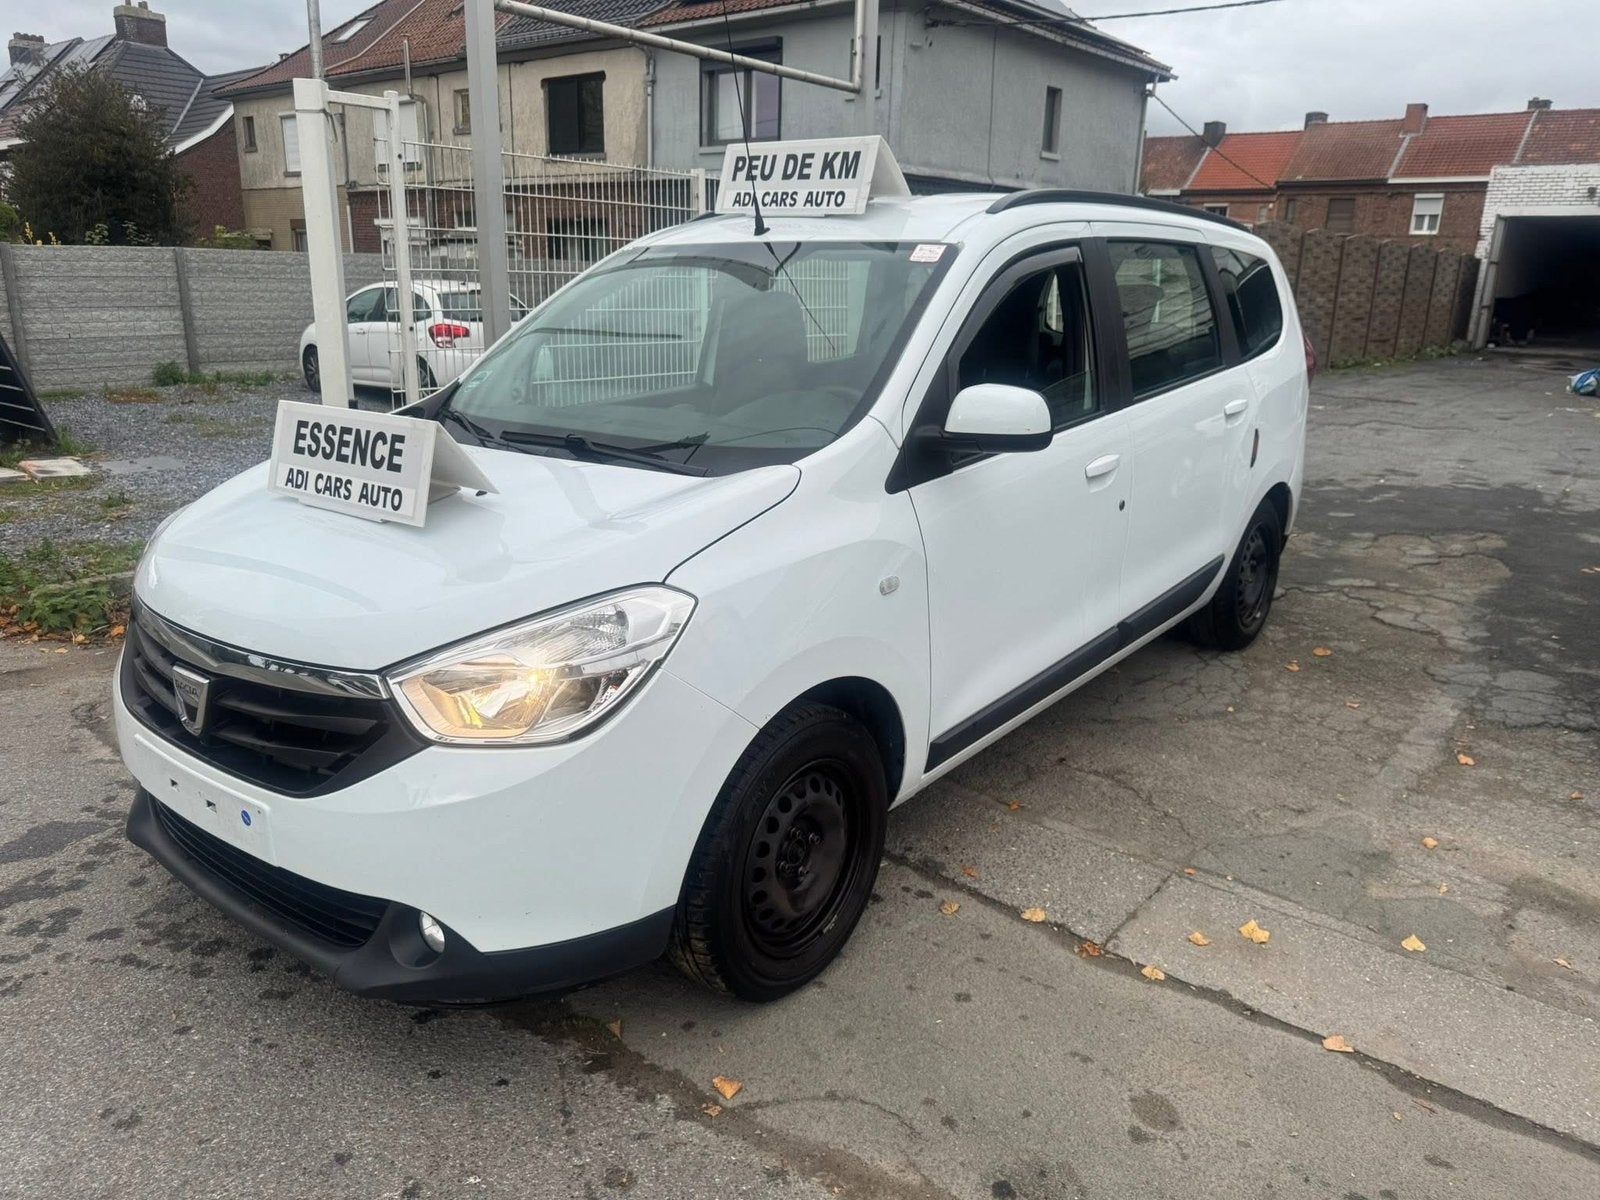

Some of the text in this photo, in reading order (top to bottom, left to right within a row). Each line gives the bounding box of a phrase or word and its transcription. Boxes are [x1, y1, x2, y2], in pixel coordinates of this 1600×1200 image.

[732, 150, 861, 182] PEU DE KM
[761, 190, 798, 207] CARS
[803, 190, 846, 207] AUTO
[293, 419, 406, 474] ESSENCE
[285, 467, 403, 512] ADI CARS AUTO
